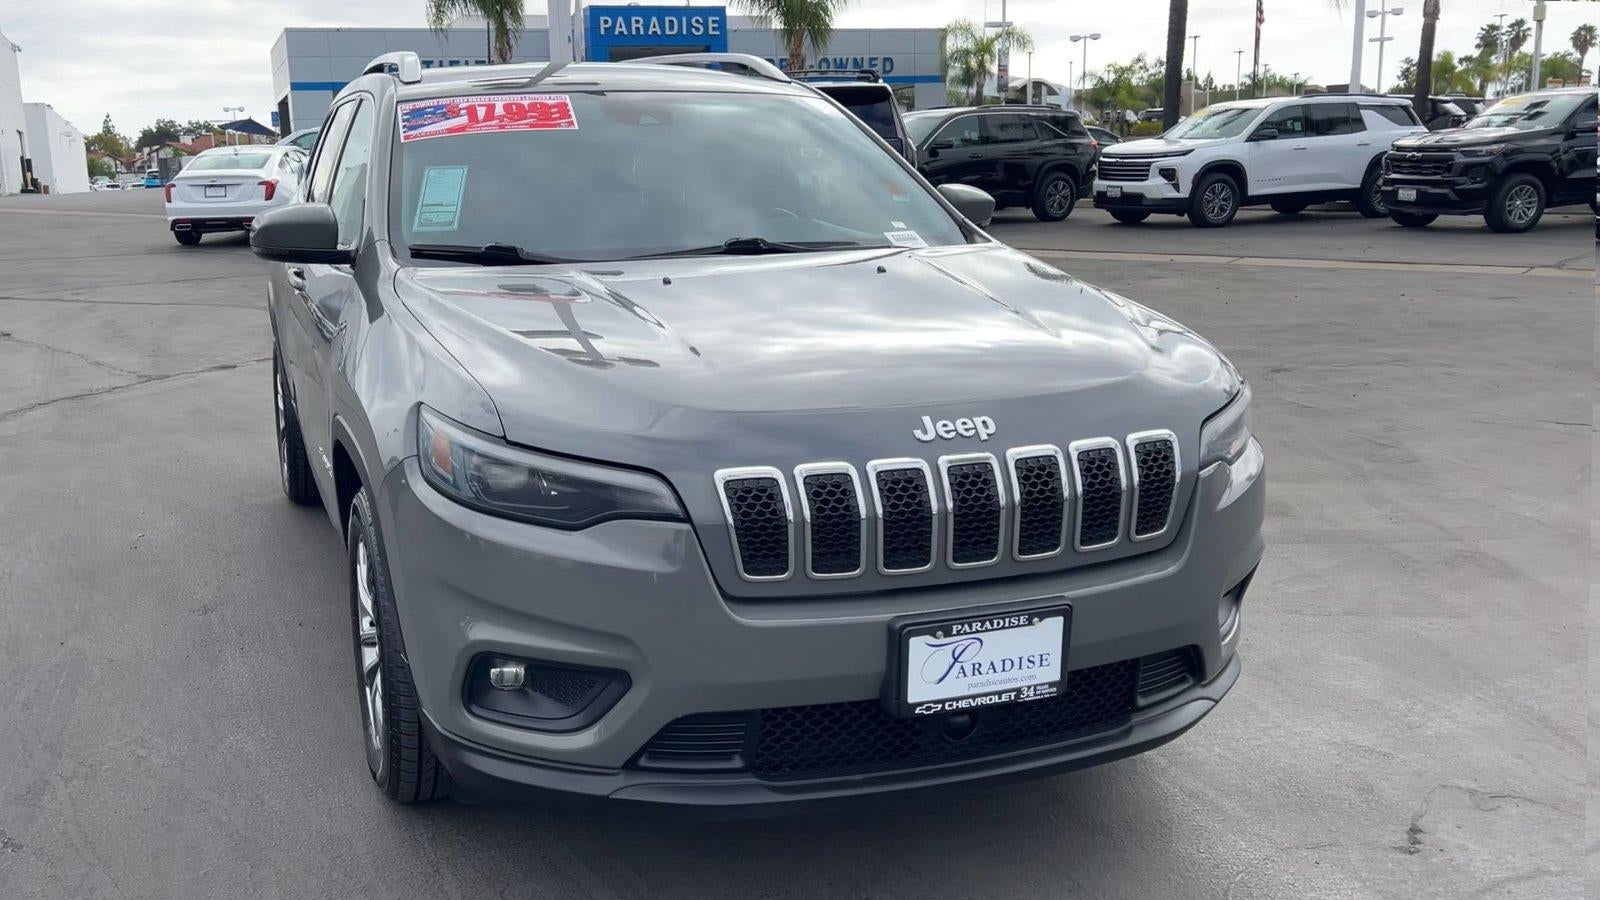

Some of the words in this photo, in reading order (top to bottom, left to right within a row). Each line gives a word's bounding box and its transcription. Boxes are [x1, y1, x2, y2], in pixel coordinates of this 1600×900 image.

[599, 16, 720, 35] PARADISE
[913, 415, 997, 442] Jeep
[951, 615, 1030, 635] PARADISE
[920, 636, 1052, 686] PARADISE
[967, 673, 1037, 692] paradiseautos.com
[944, 691, 1017, 711] CHEVROLET
[1020, 685, 1035, 698] 34
